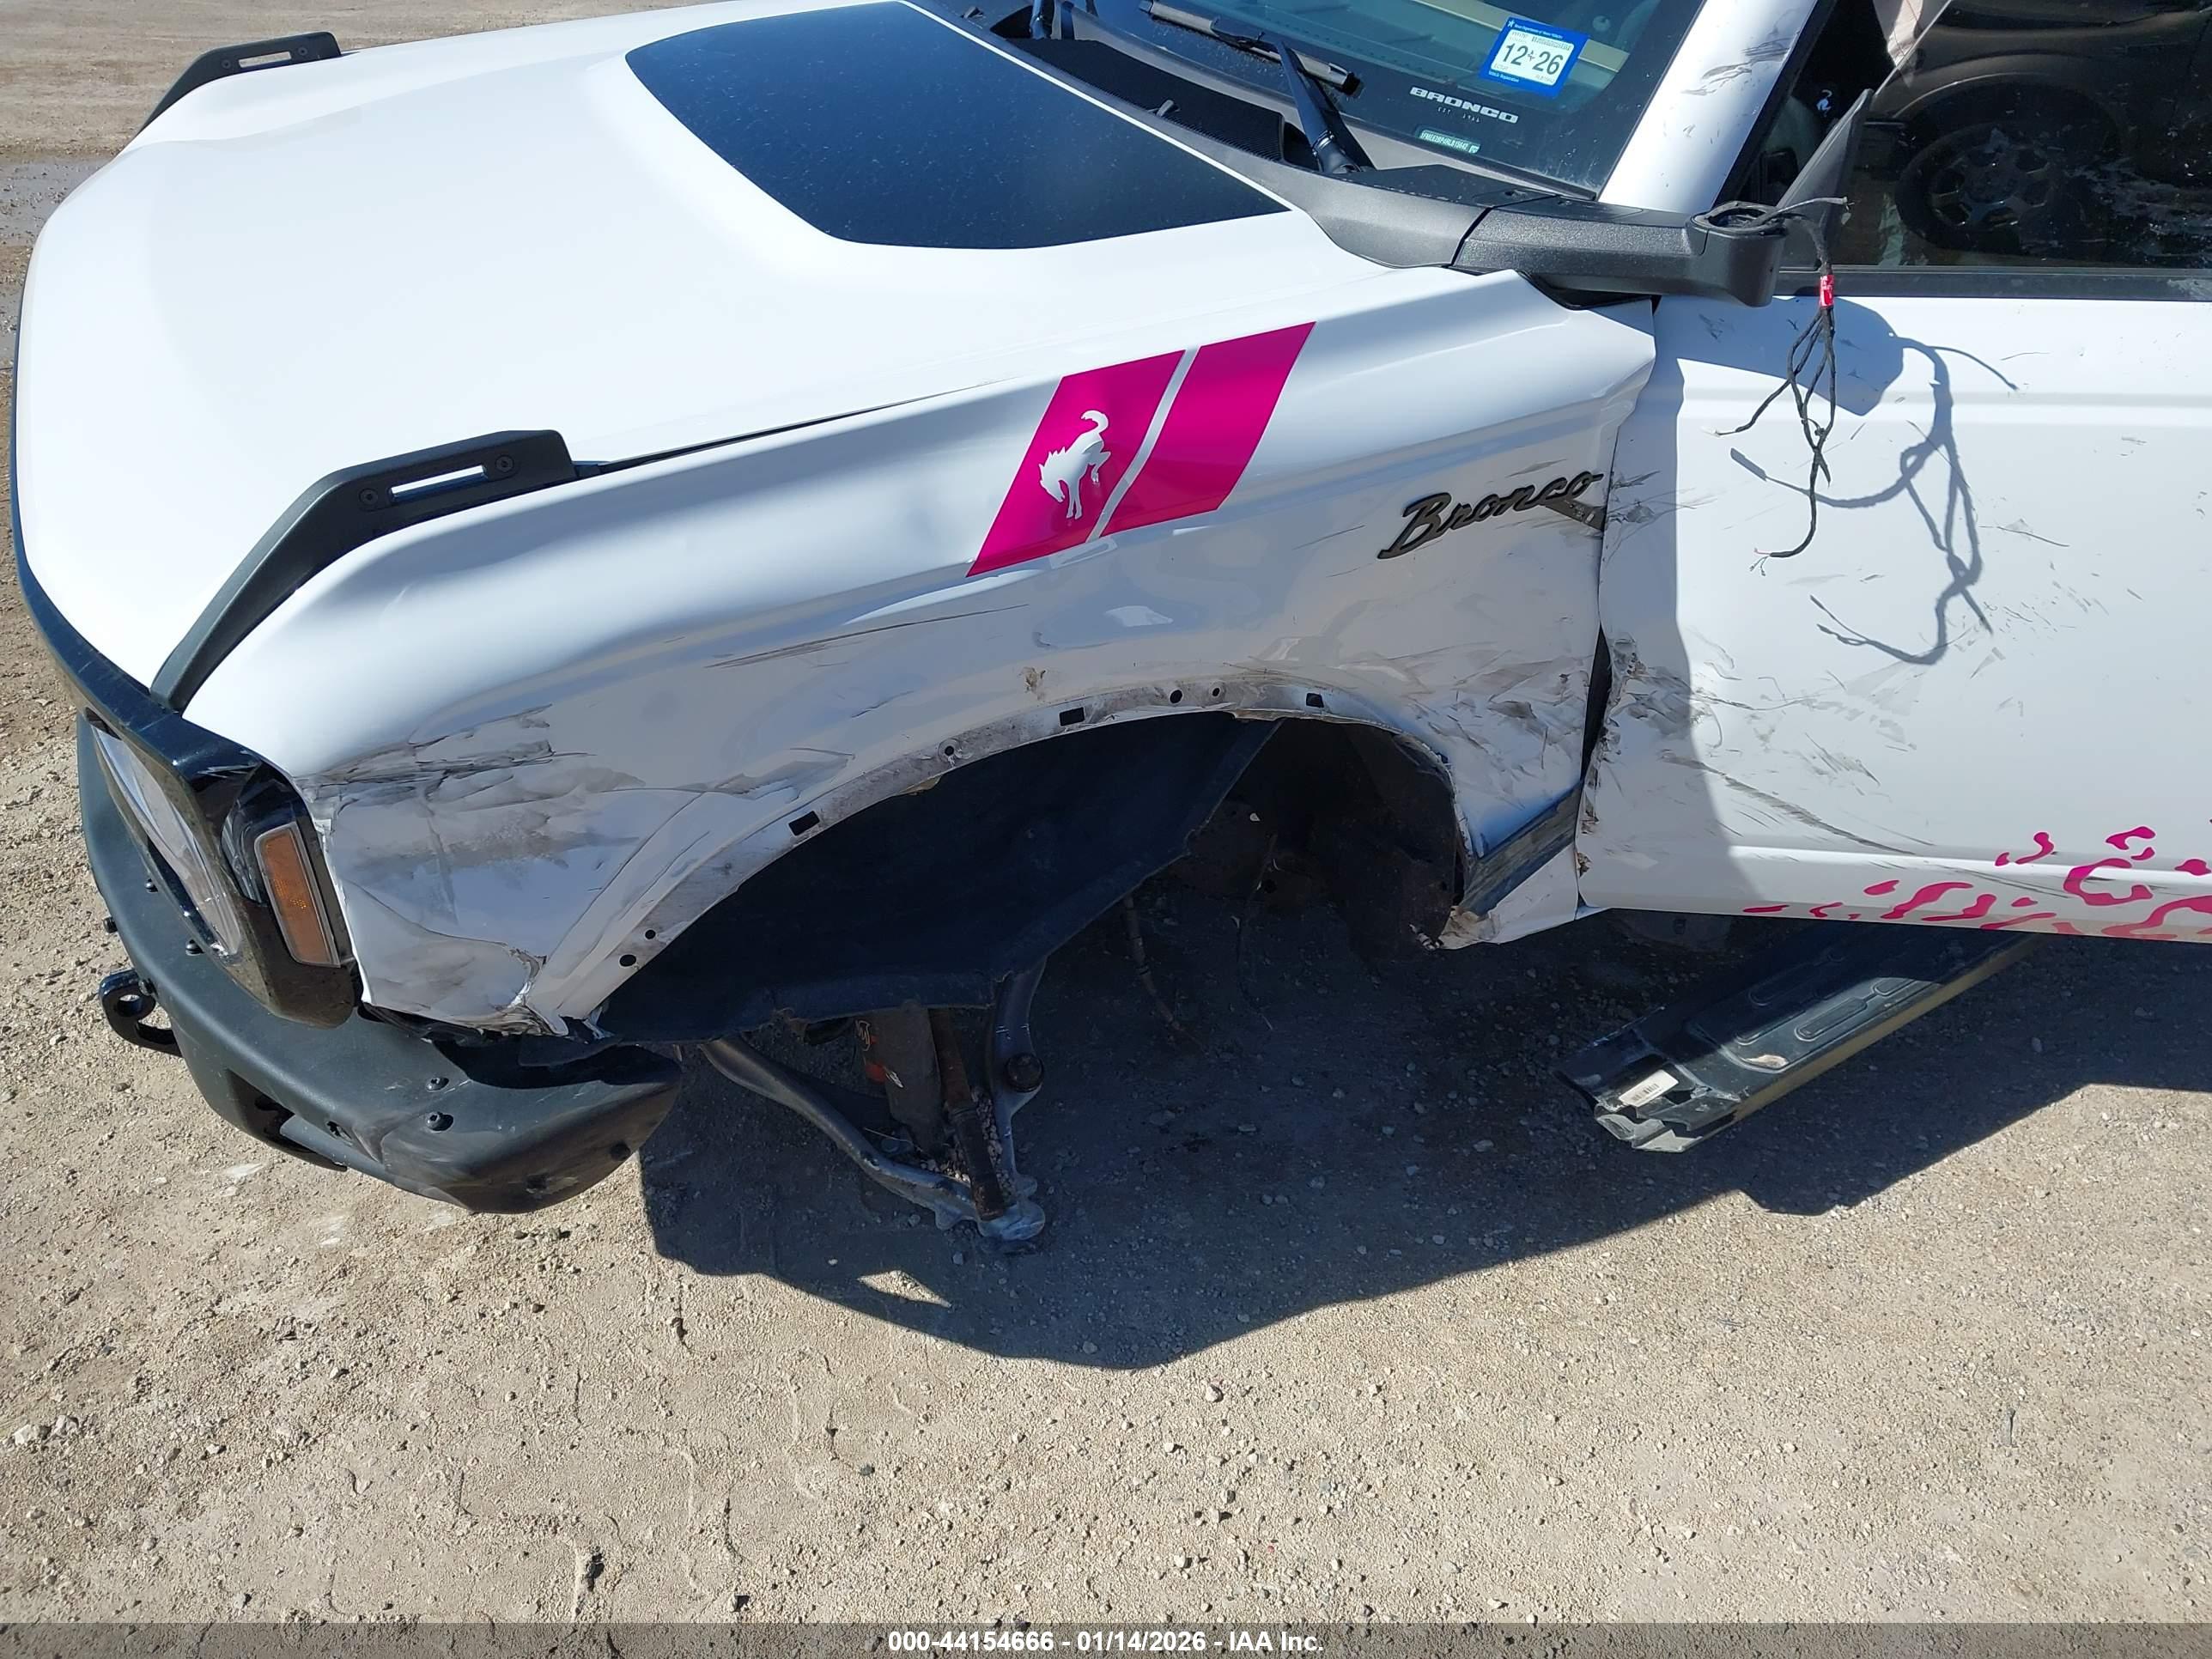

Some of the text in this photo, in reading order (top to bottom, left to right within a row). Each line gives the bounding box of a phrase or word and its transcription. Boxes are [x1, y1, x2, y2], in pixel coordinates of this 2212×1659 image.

[1503, 43, 1528, 66] 12
[1532, 51, 1564, 76] 26
[1410, 87, 1519, 124] BRONCO
[1377, 471, 1604, 559] Bronco
